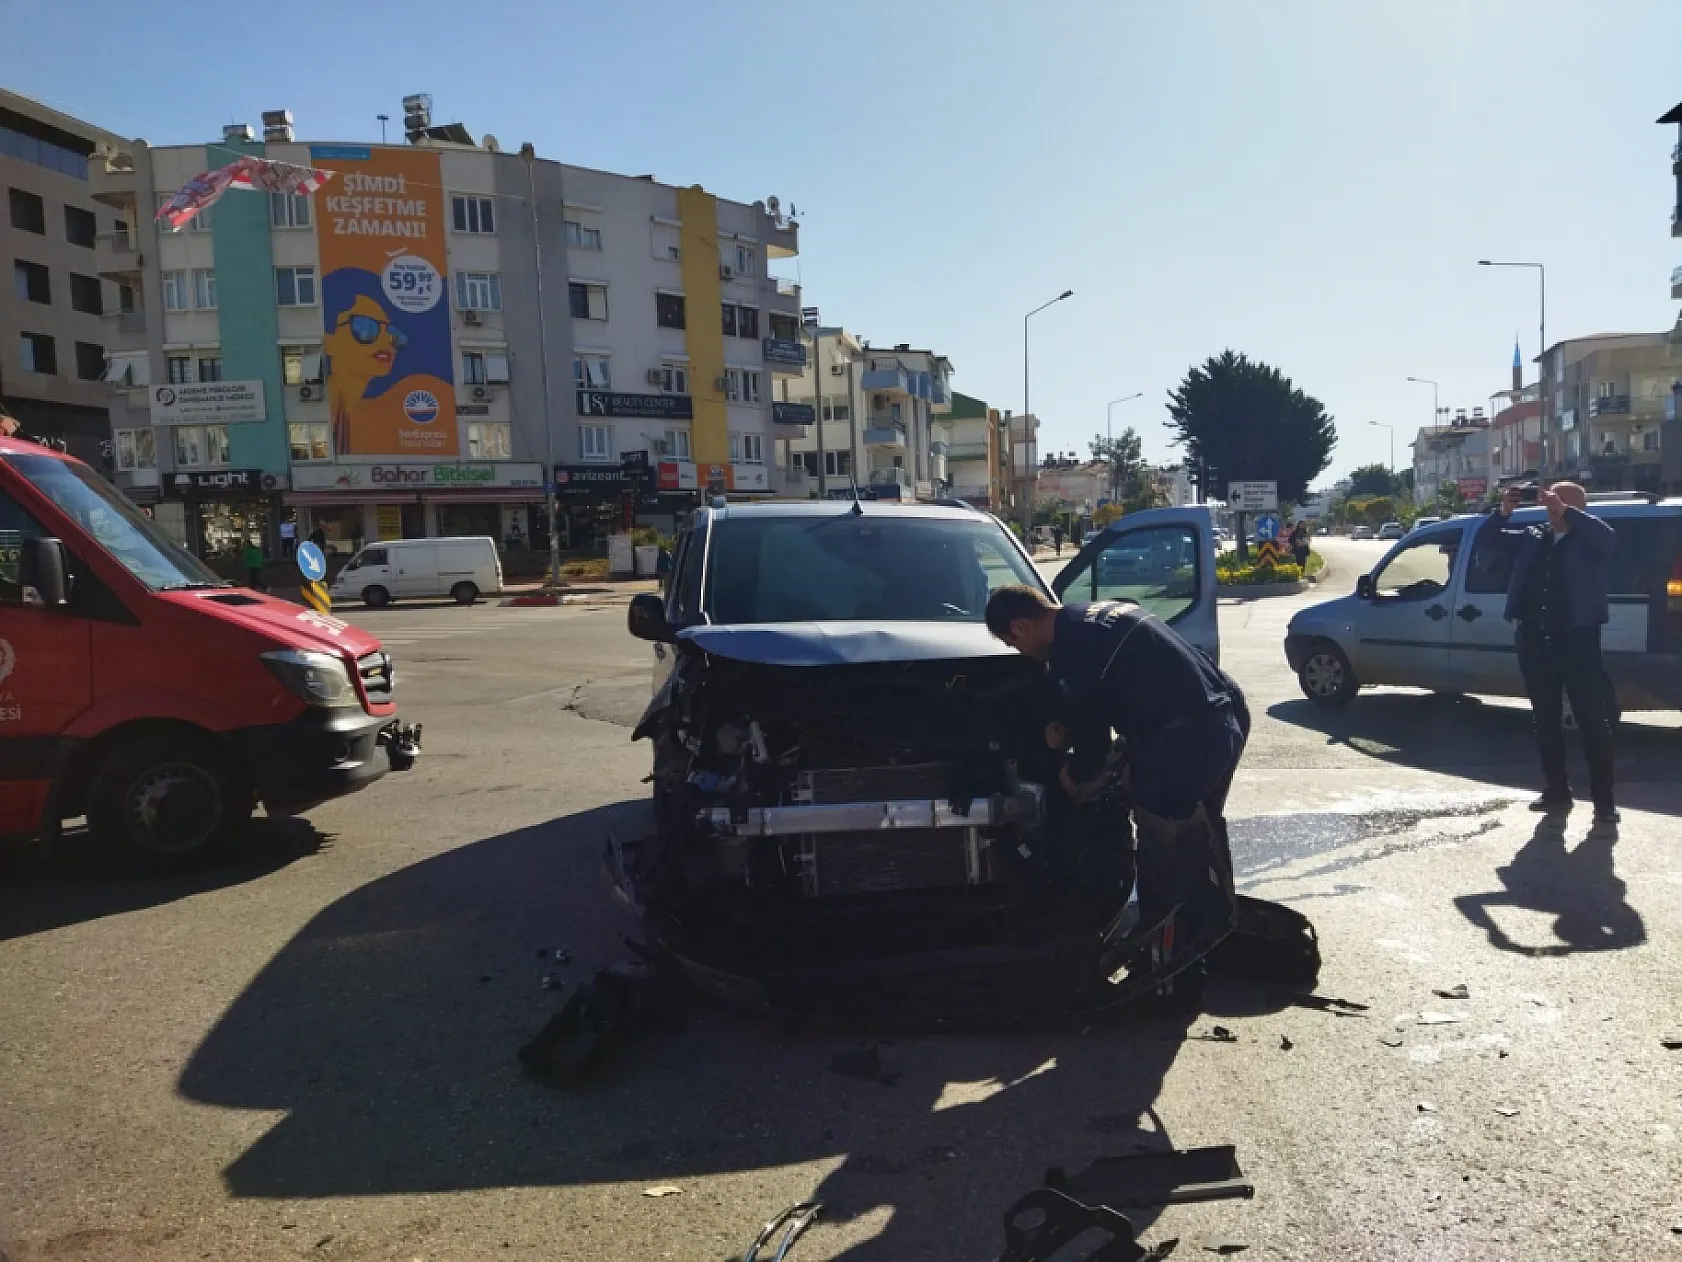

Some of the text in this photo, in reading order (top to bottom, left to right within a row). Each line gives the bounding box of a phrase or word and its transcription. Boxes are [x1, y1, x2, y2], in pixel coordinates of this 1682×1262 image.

[343, 170, 406, 195] ŞİMDİ
[325, 196, 426, 217] KEŞFETME
[332, 218, 428, 238] ZAMANI!
[371, 464, 496, 483] Bahar Bitkisel
